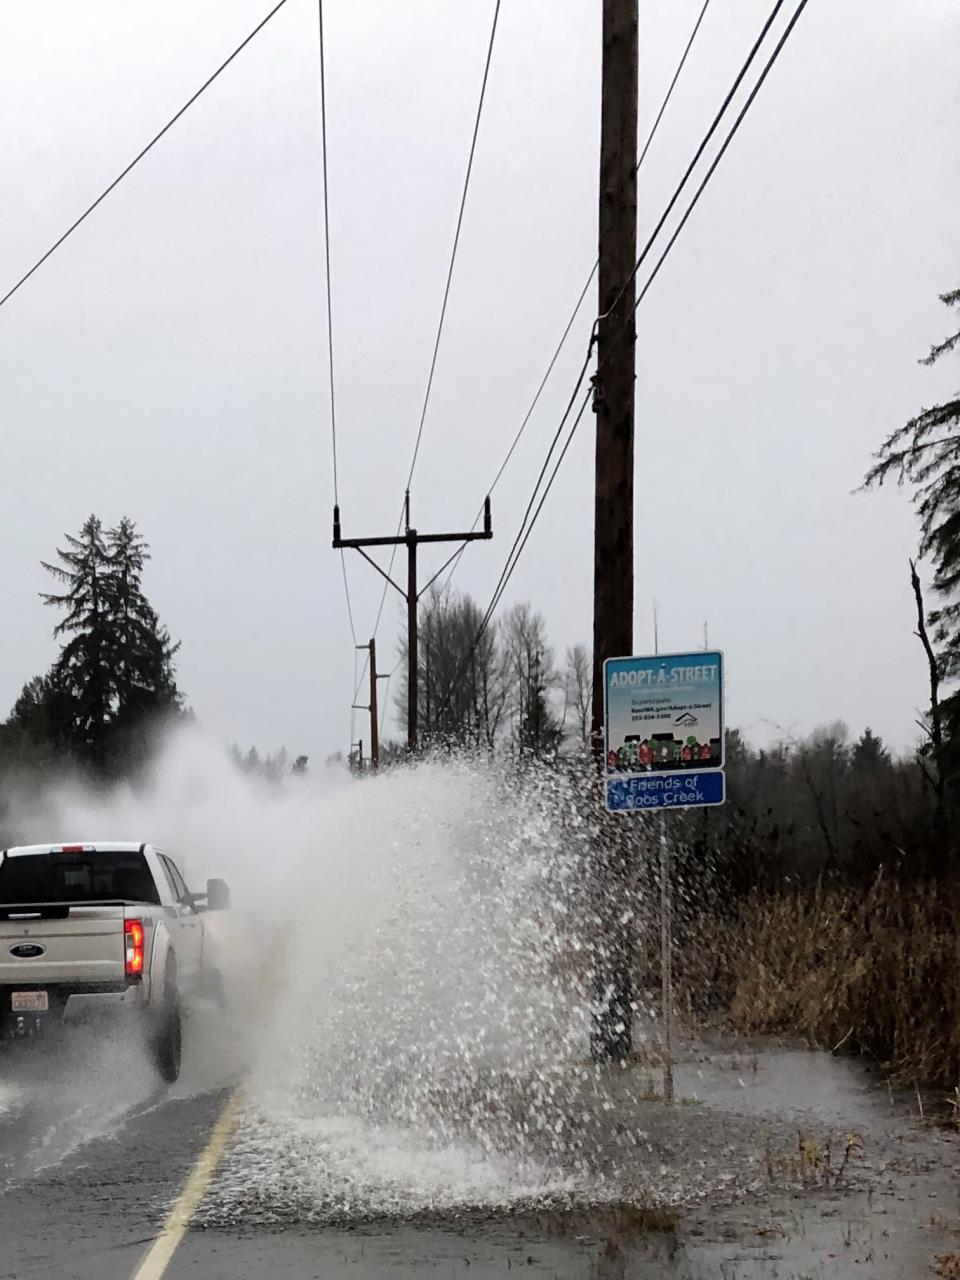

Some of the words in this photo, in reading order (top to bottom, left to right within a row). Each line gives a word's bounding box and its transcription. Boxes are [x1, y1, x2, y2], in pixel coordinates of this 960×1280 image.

[630, 776, 681, 792] Friends
[685, 775, 699, 787] of
[663, 790, 705, 804] Creek
